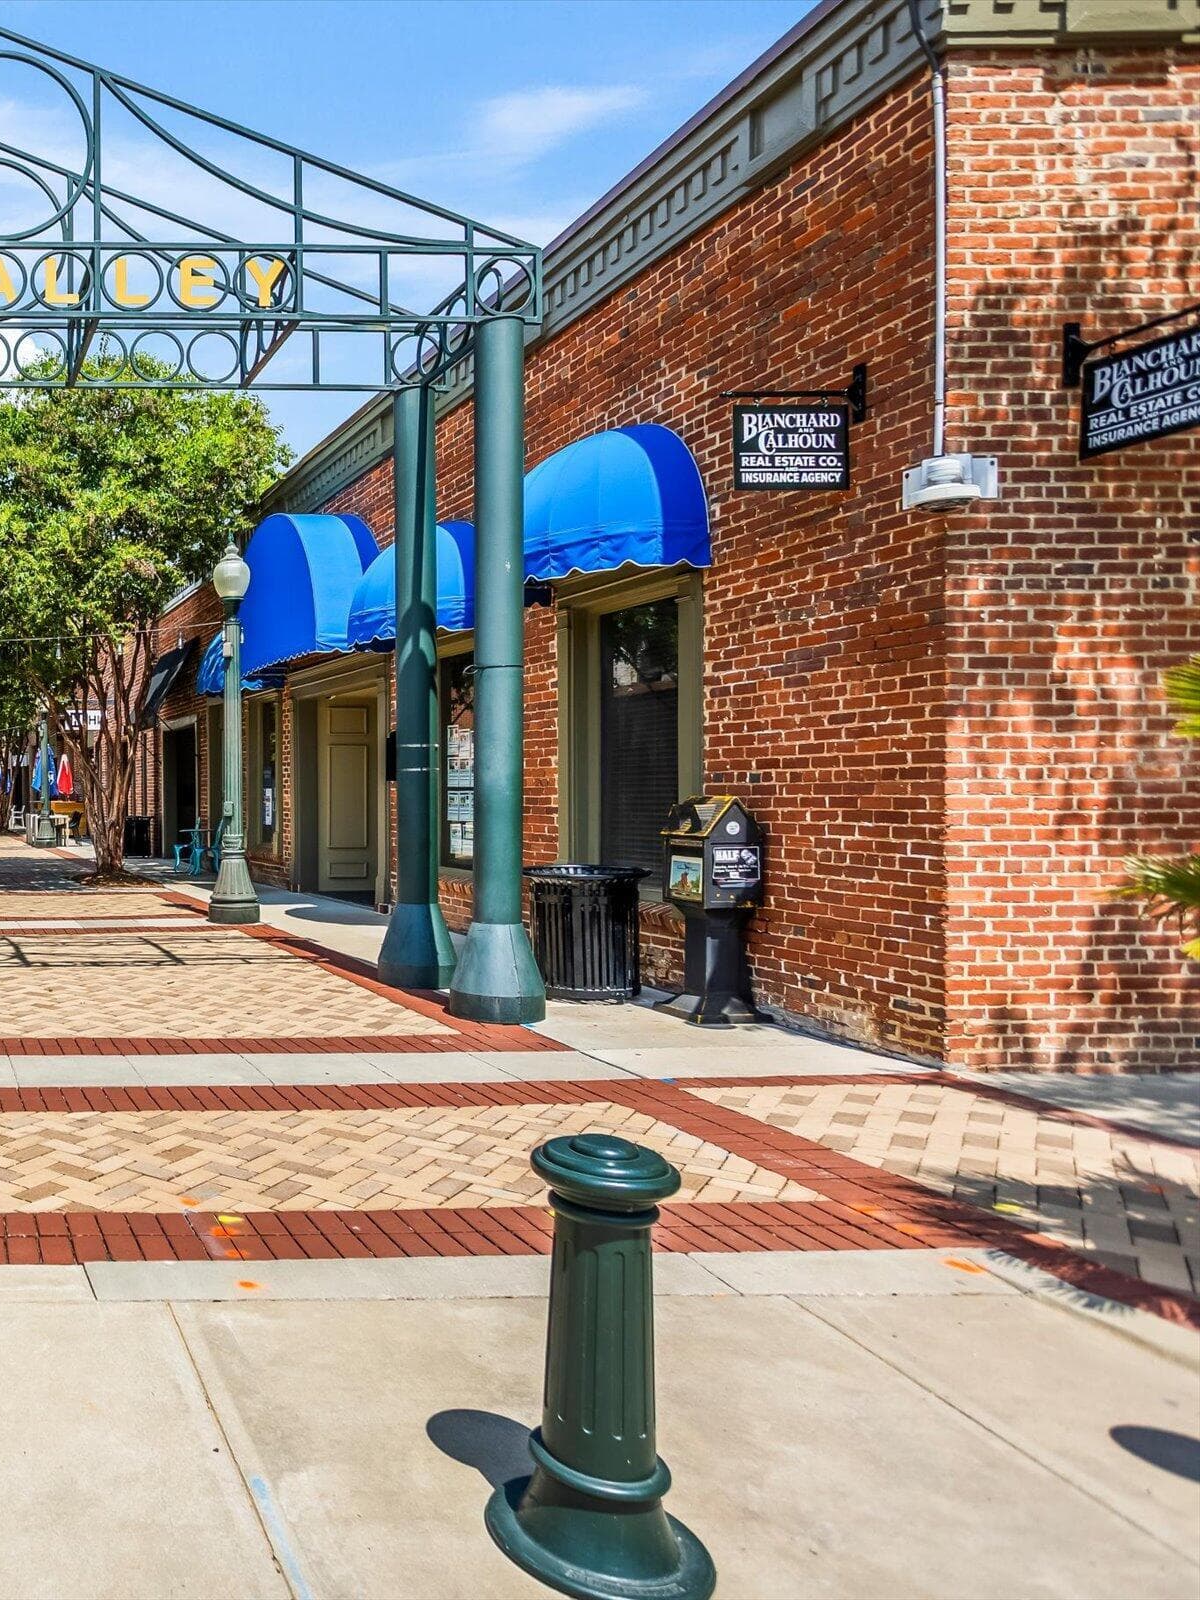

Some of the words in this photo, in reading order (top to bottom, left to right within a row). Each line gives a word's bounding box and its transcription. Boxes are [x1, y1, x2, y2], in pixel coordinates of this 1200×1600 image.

[1163, 357, 1184, 368] AND
[1089, 411, 1125, 430] REAL
[1130, 392, 1182, 417] ESTATE
[1186, 386, 1200, 400] C
[741, 413, 841, 443] BLANCHARD
[1088, 418, 1160, 449] INSURANCE
[1161, 404, 1200, 428] AGEN
[758, 429, 836, 455] CALHOUN
[741, 456, 772, 467] REAL
[774, 456, 815, 467] ESTATE
[819, 456, 842, 467] CO.
[741, 472, 799, 483] INSURANCE
[800, 472, 842, 483] AGENCY
